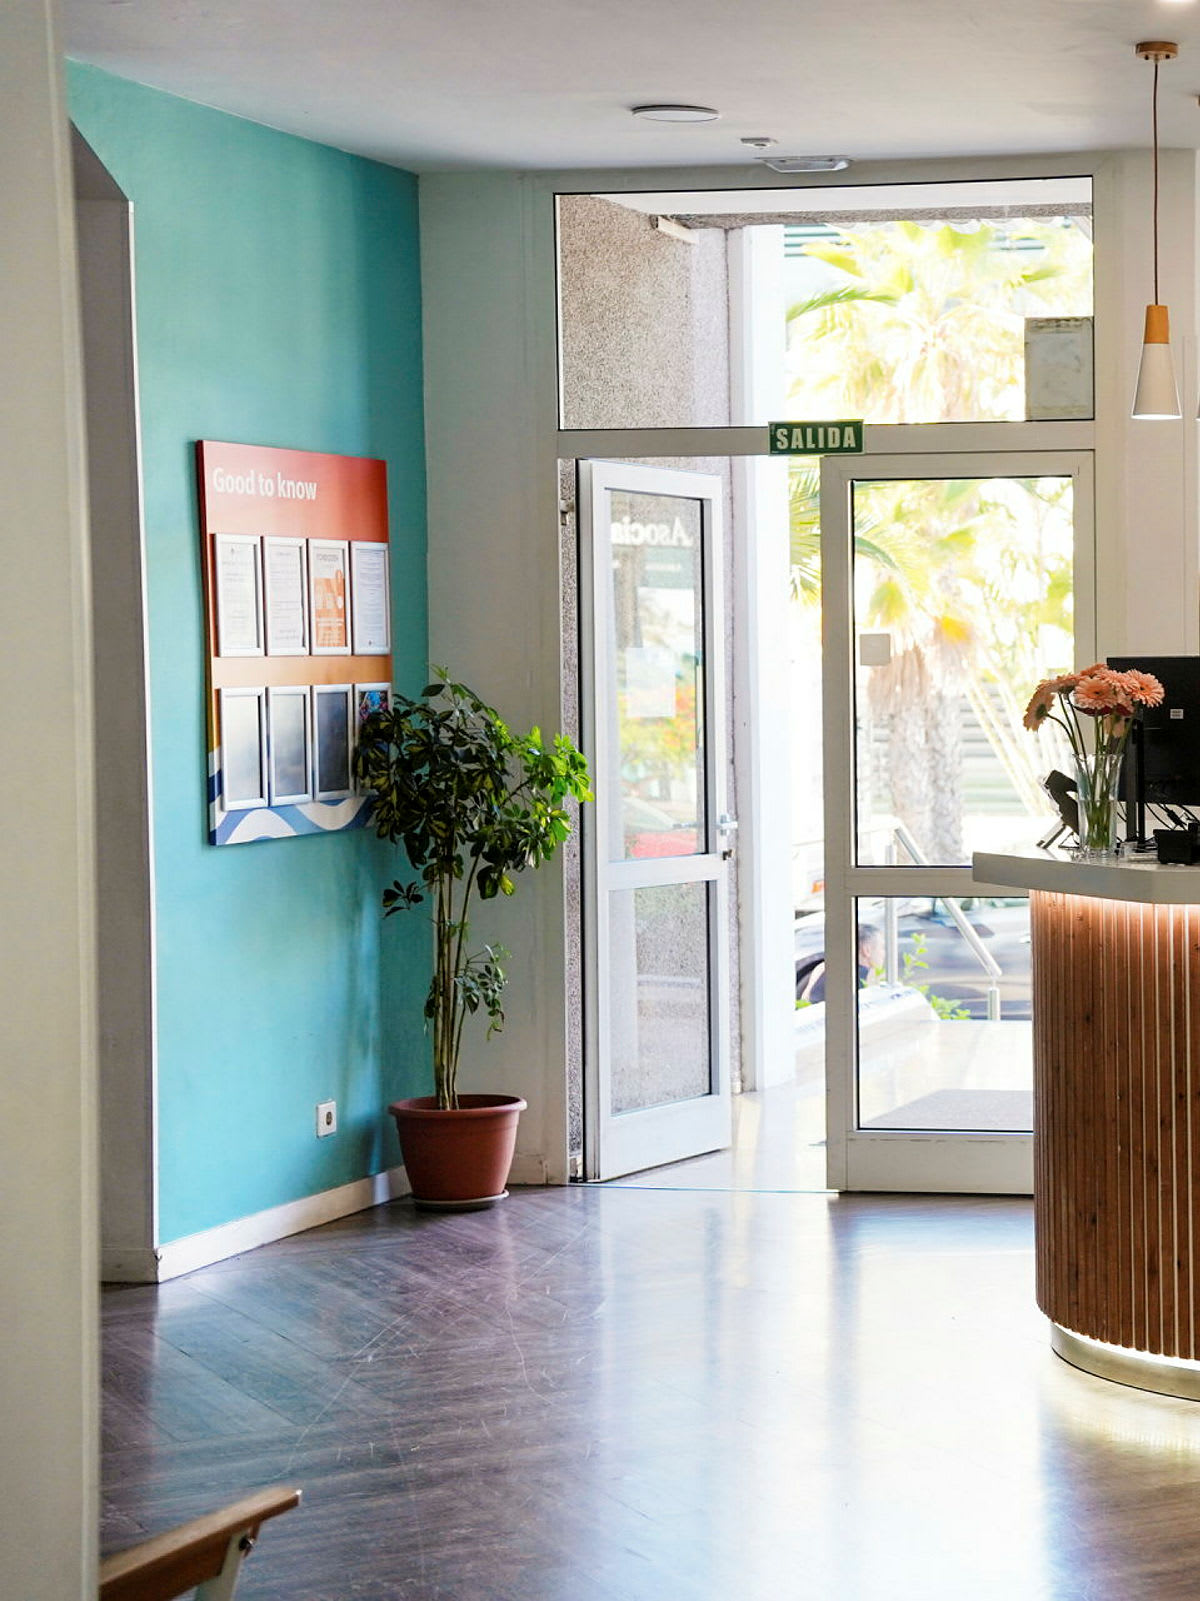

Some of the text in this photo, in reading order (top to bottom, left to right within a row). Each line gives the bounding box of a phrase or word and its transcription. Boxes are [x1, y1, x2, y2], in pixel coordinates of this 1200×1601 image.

[776, 426, 856, 449] SALIDA
[213, 467, 317, 500] Good to know
